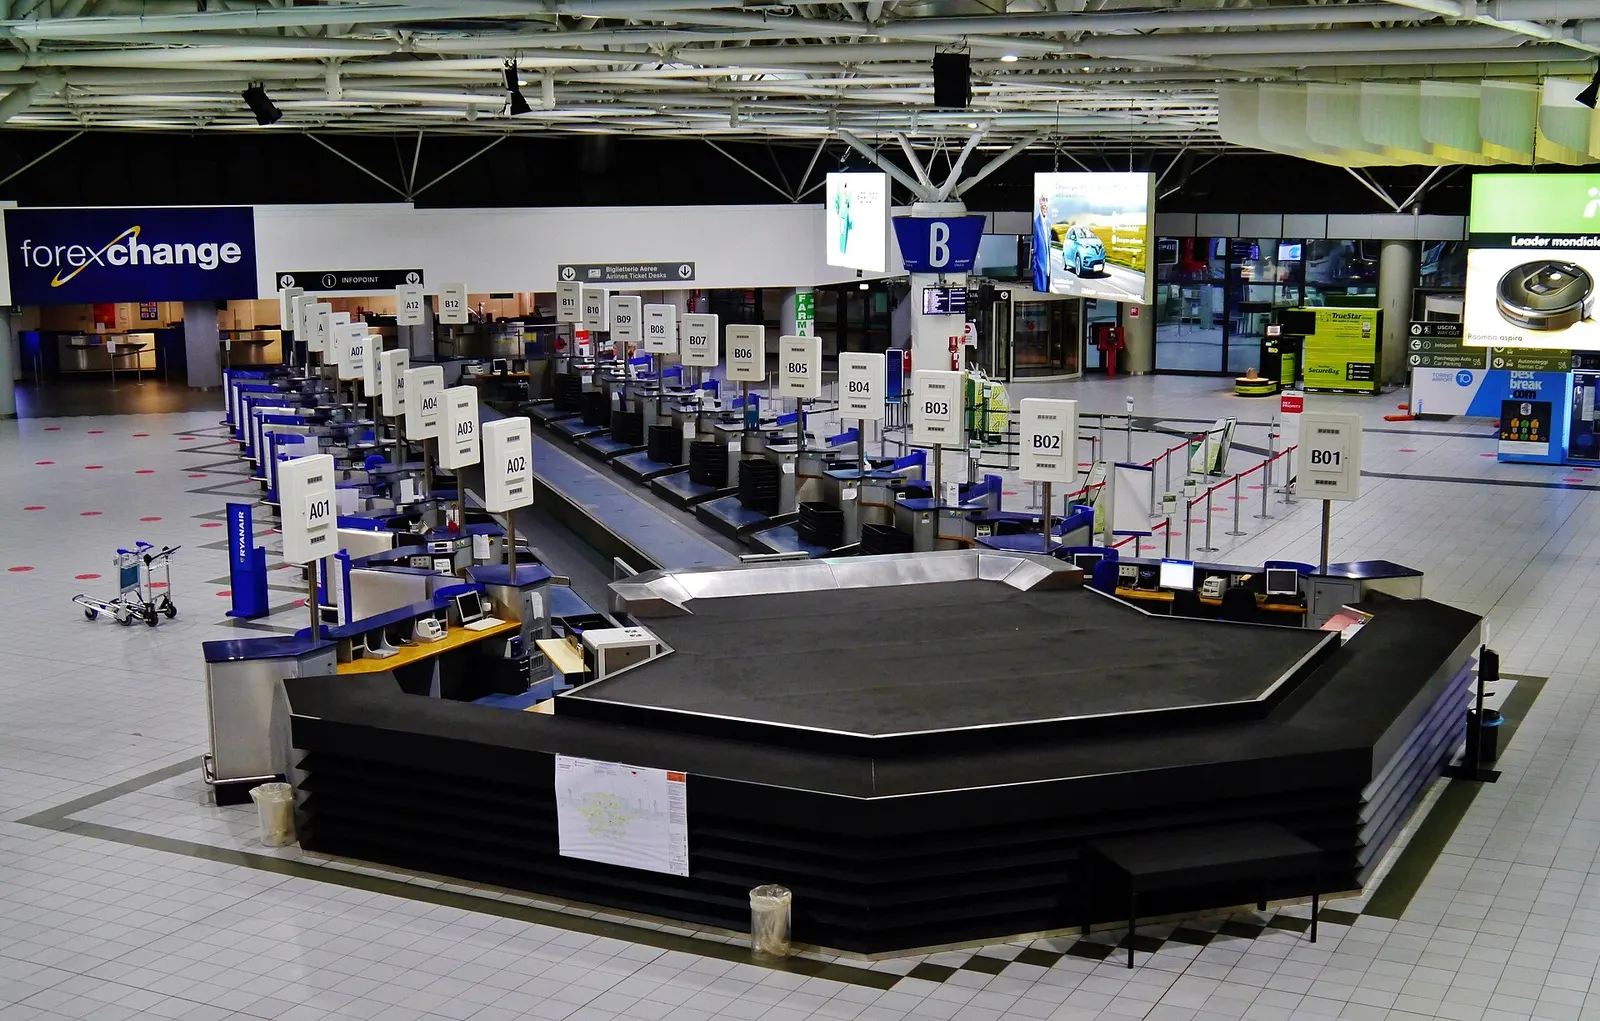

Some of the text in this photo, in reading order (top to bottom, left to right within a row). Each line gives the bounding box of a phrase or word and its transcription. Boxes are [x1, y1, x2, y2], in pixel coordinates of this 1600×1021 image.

[929, 221, 950, 268] B
[1511, 236, 1550, 246] Leader
[20, 236, 242, 270] forexchange
[445, 300, 458, 308] B12
[587, 306, 599, 314] B10
[616, 315, 631, 324] B09
[650, 325, 664, 334] B08
[690, 336, 706, 345] B07
[1468, 332, 1497, 341] Roomba
[351, 346, 363, 356] A07
[734, 349, 752, 359] B06
[788, 361, 808, 373] B05
[848, 380, 870, 393] B04
[1510, 380, 1542, 389] break
[1510, 390, 1536, 399] .com
[422, 396, 437, 411] A04
[925, 402, 948, 414] B03
[458, 421, 472, 436] A03
[1033, 435, 1060, 448] B02
[1312, 450, 1340, 465] B01
[507, 456, 525, 474] A02
[309, 499, 330, 519] A01
